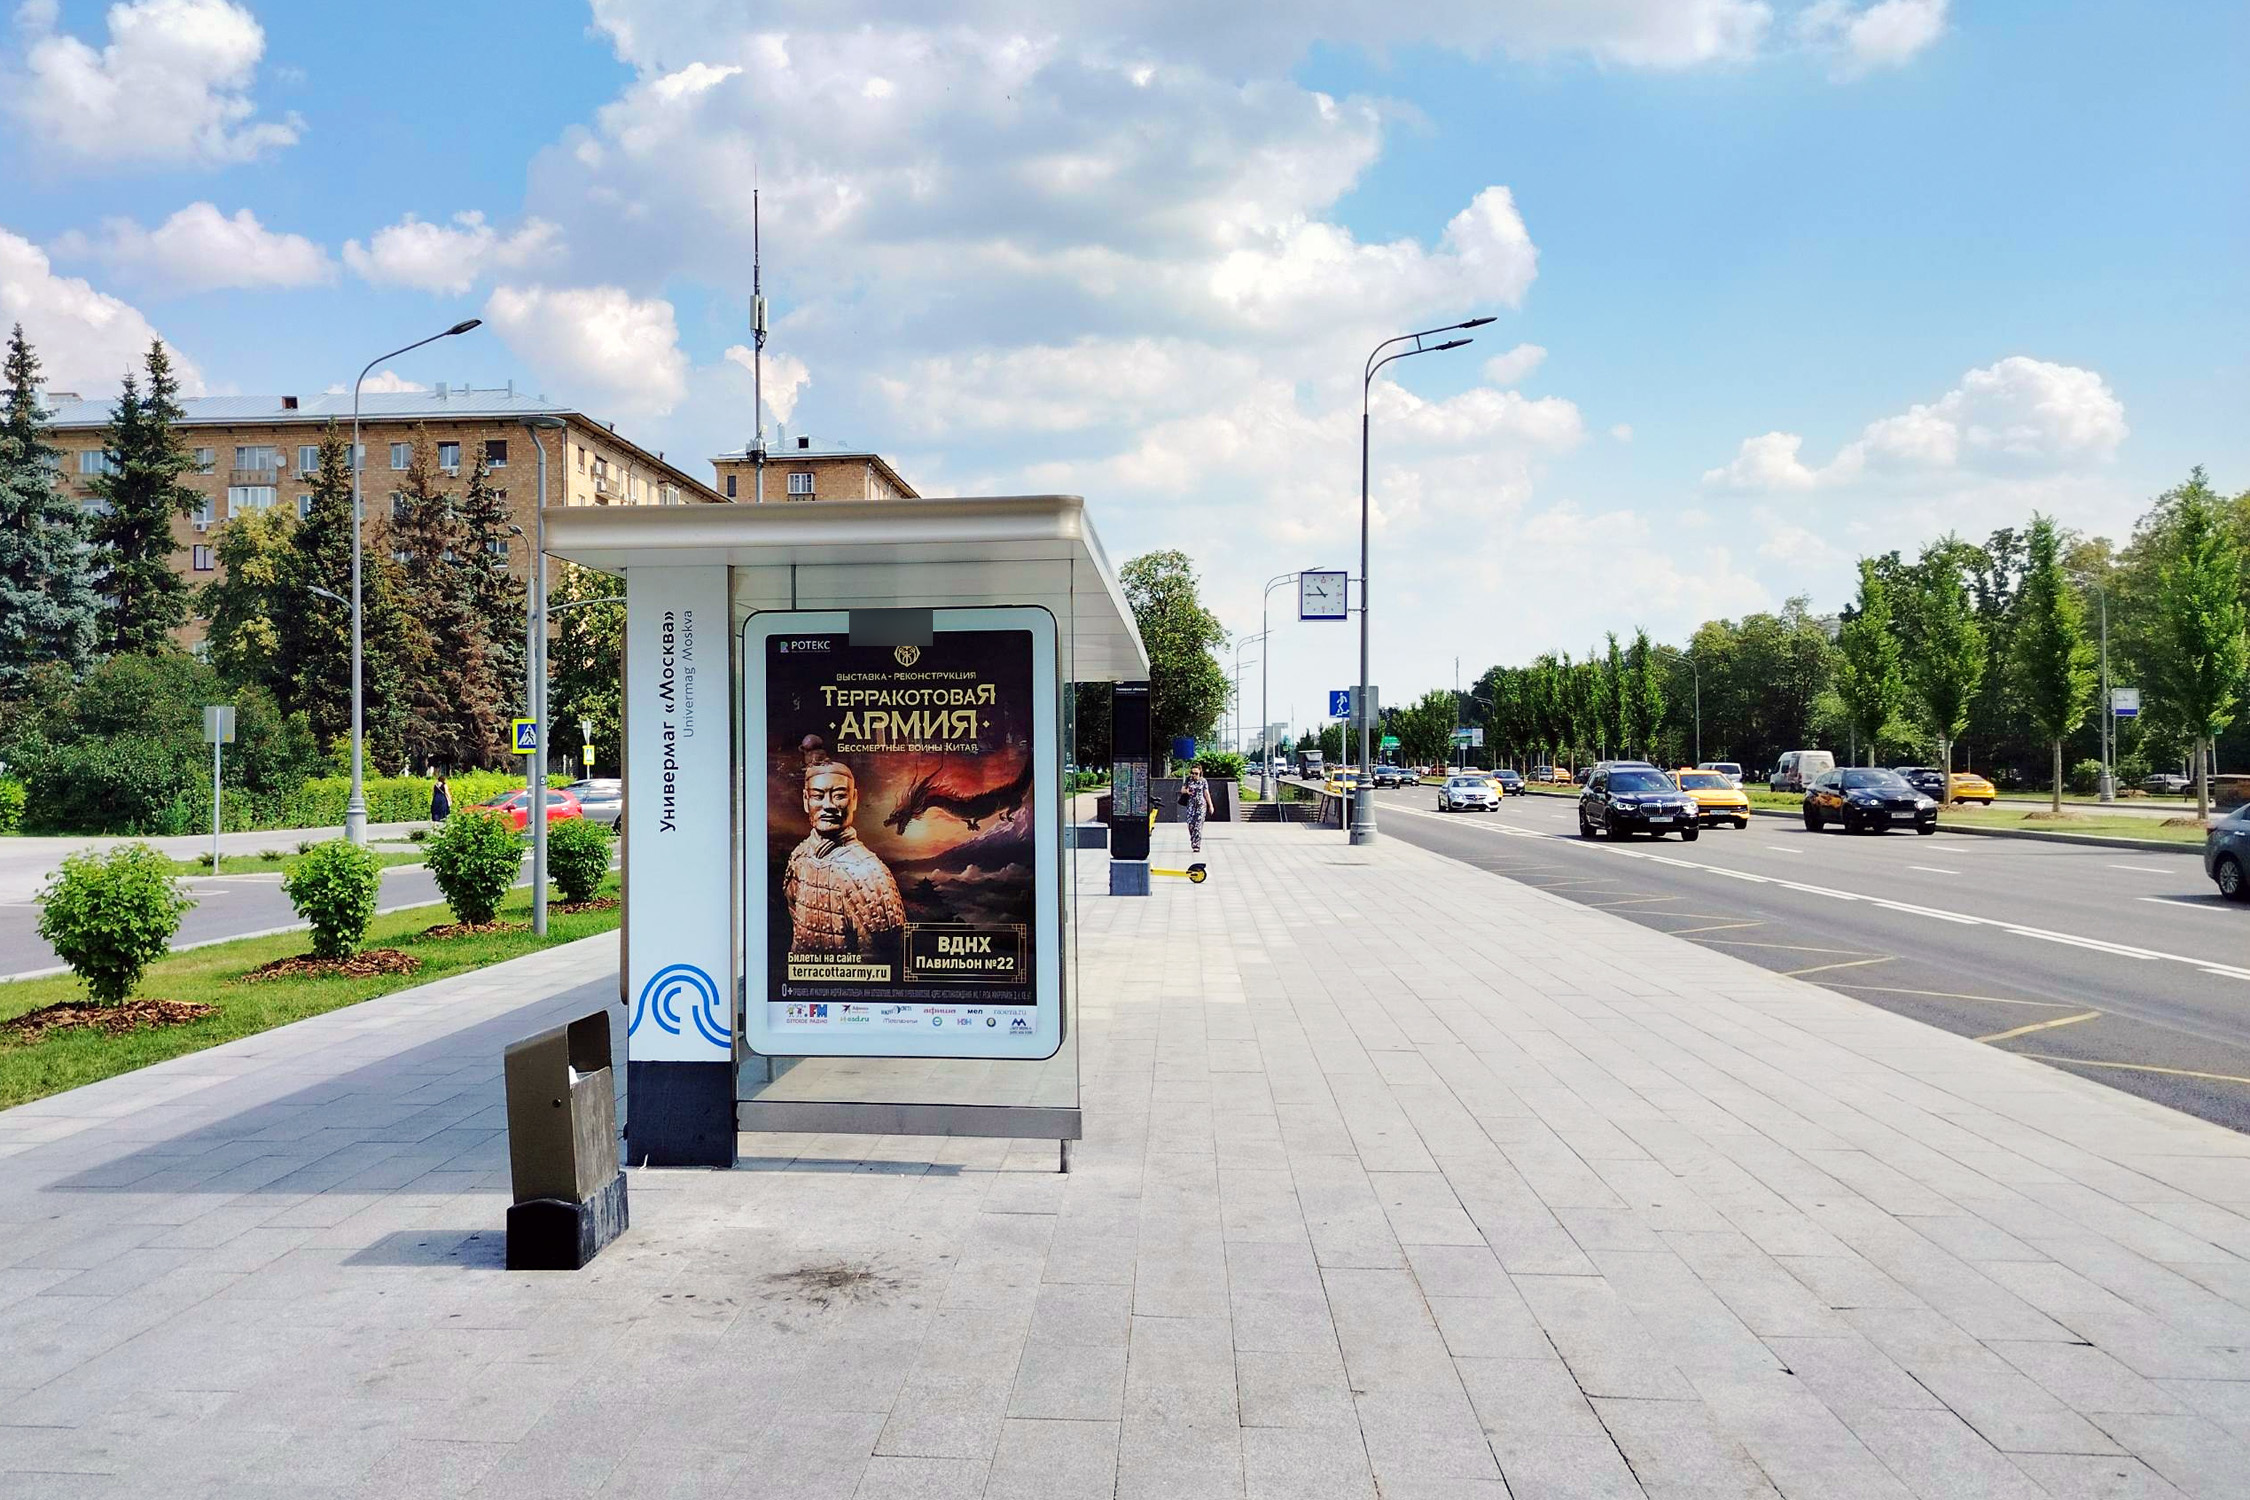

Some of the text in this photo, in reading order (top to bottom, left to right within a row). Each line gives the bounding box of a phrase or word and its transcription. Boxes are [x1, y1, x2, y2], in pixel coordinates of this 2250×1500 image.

[791, 641, 830, 650] РОТЕКС
[681, 610, 696, 738] Univermag Moskva
[659, 610, 679, 833] Универмаг «Москва»
[838, 710, 978, 739] АРМИЯ
[938, 936, 991, 956] ВДНХ
[787, 952, 862, 964] Билеты на сайте
[984, 957, 1014, 970] №22
[792, 966, 888, 981] terracottaarmy.ru
[782, 984, 793, 997] 0+
[809, 1003, 828, 1018] FM
